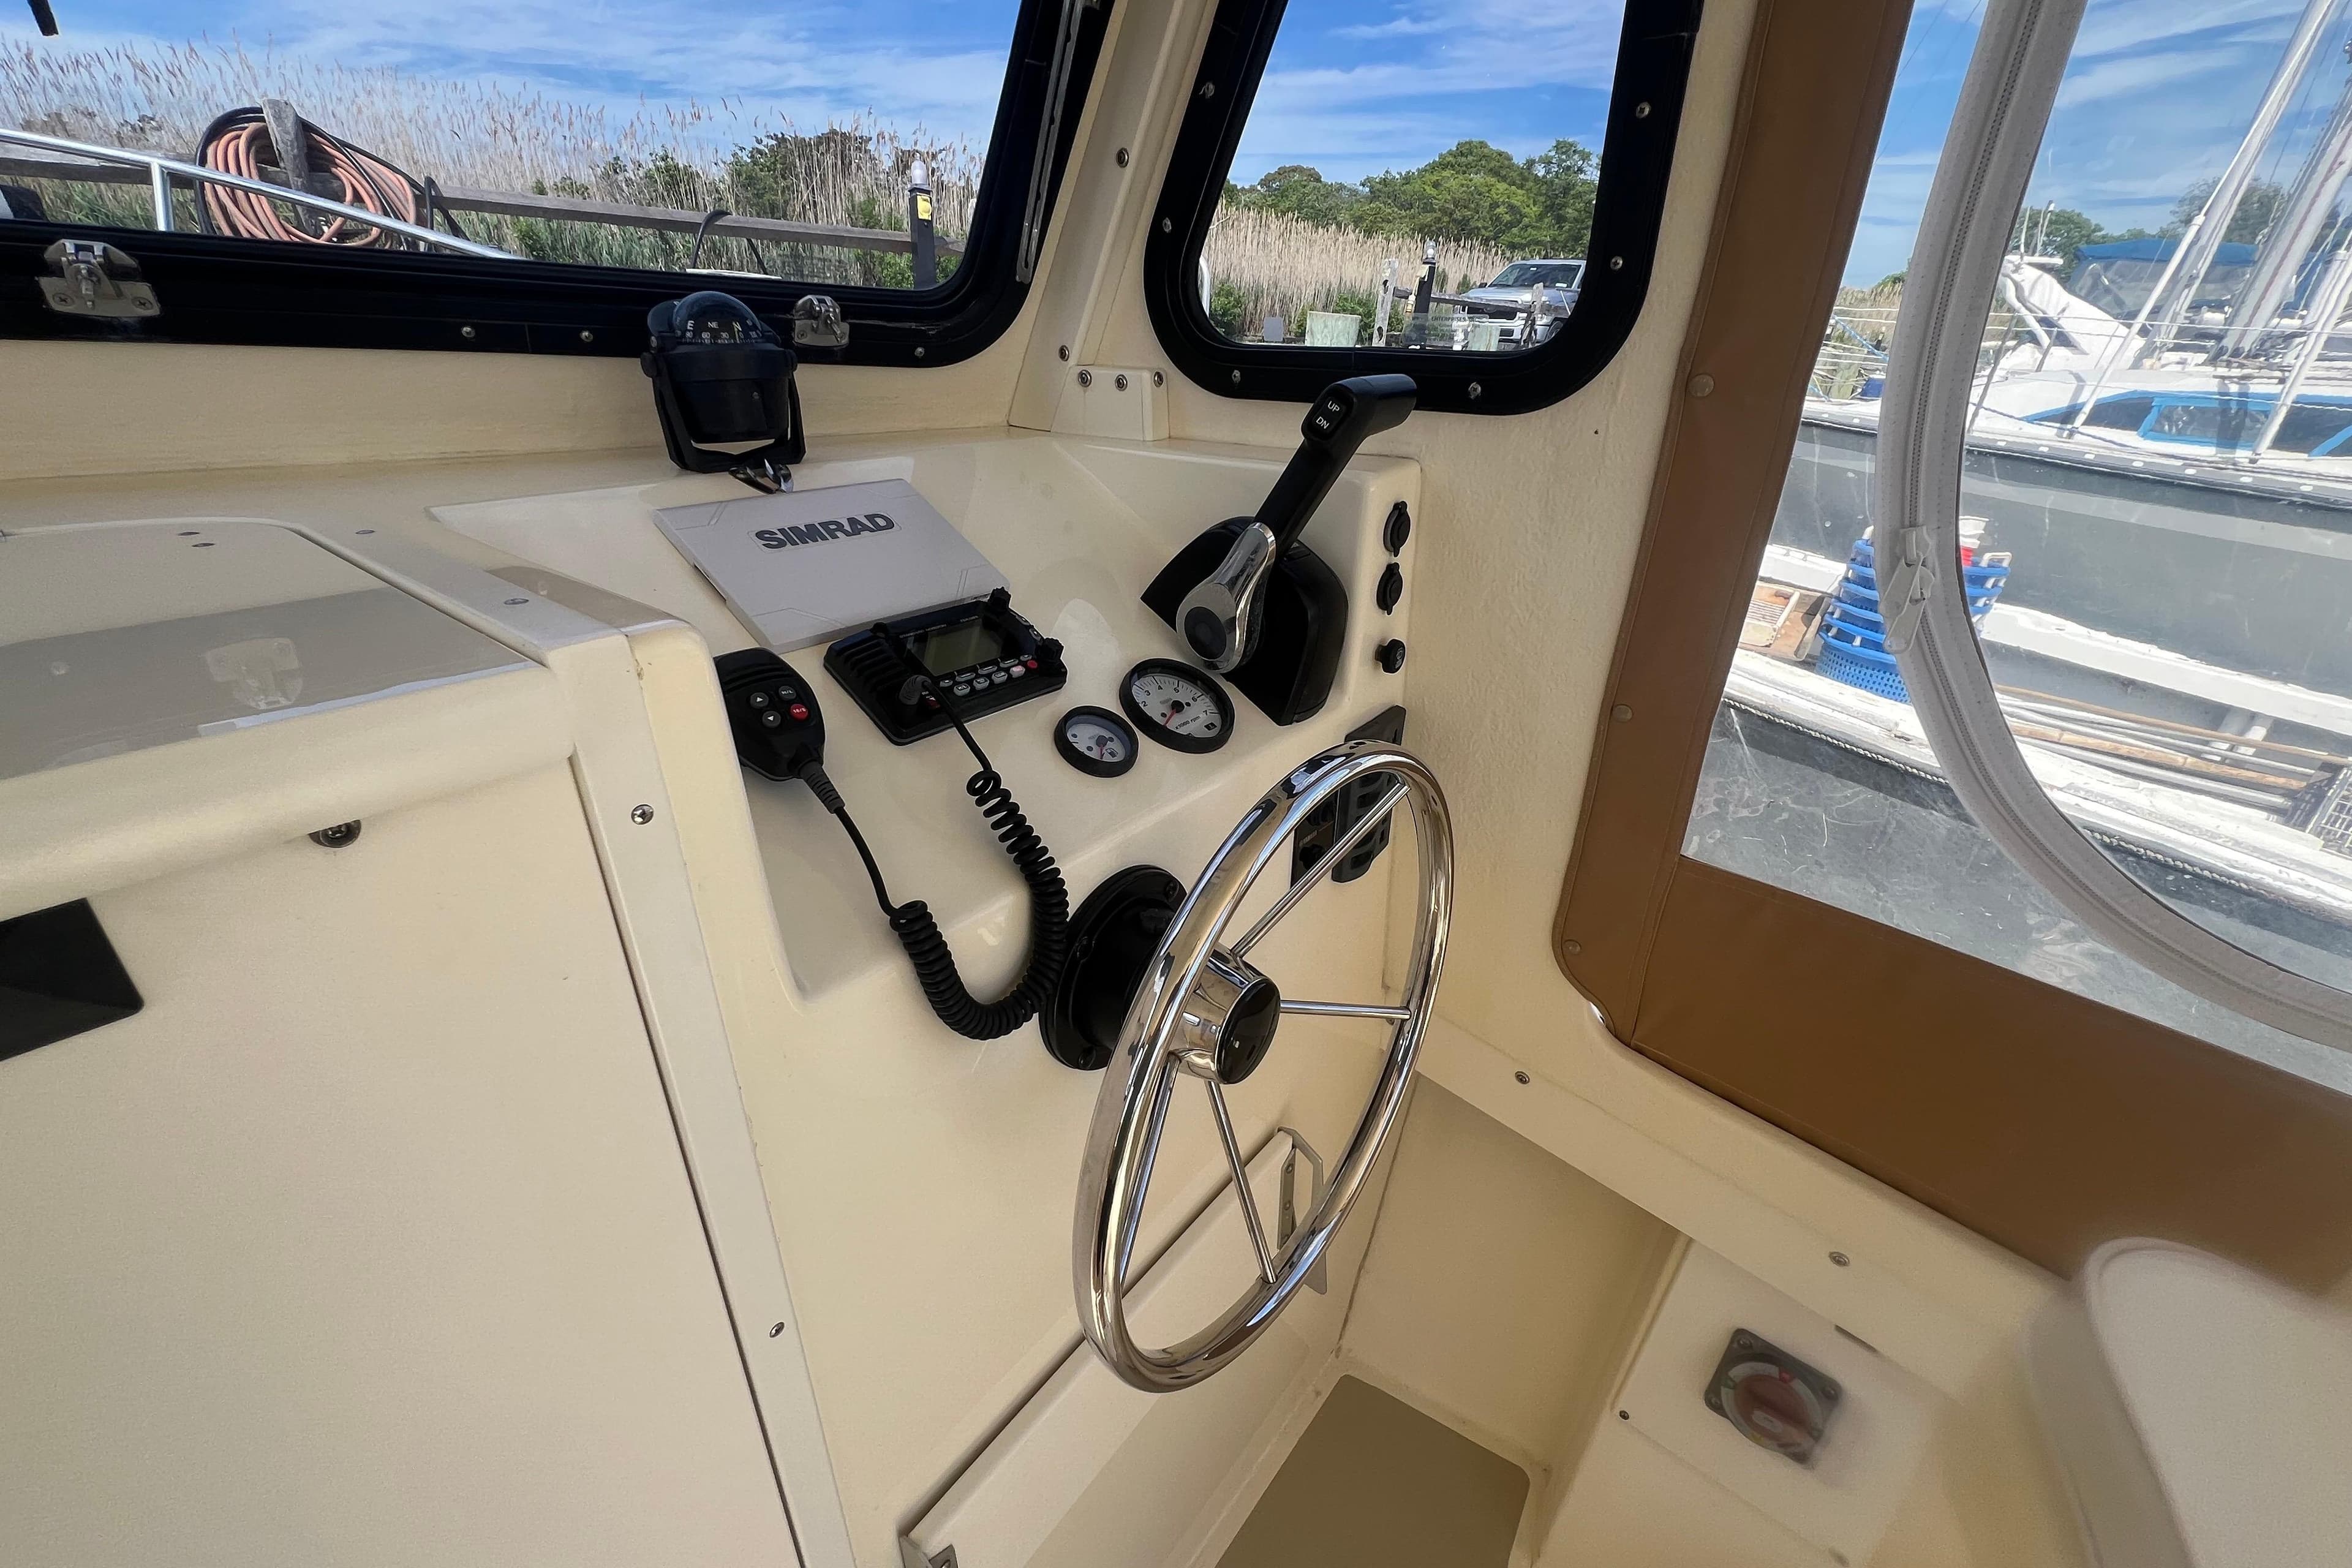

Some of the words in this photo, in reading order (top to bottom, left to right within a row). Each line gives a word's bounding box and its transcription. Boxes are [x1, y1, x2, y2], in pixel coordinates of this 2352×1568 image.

[687, 320, 695, 331] E
[732, 320, 742, 331] N
[1327, 400, 1340, 412] UP
[1316, 416, 1330, 429] DN
[755, 513, 895, 549] SIMRAD
